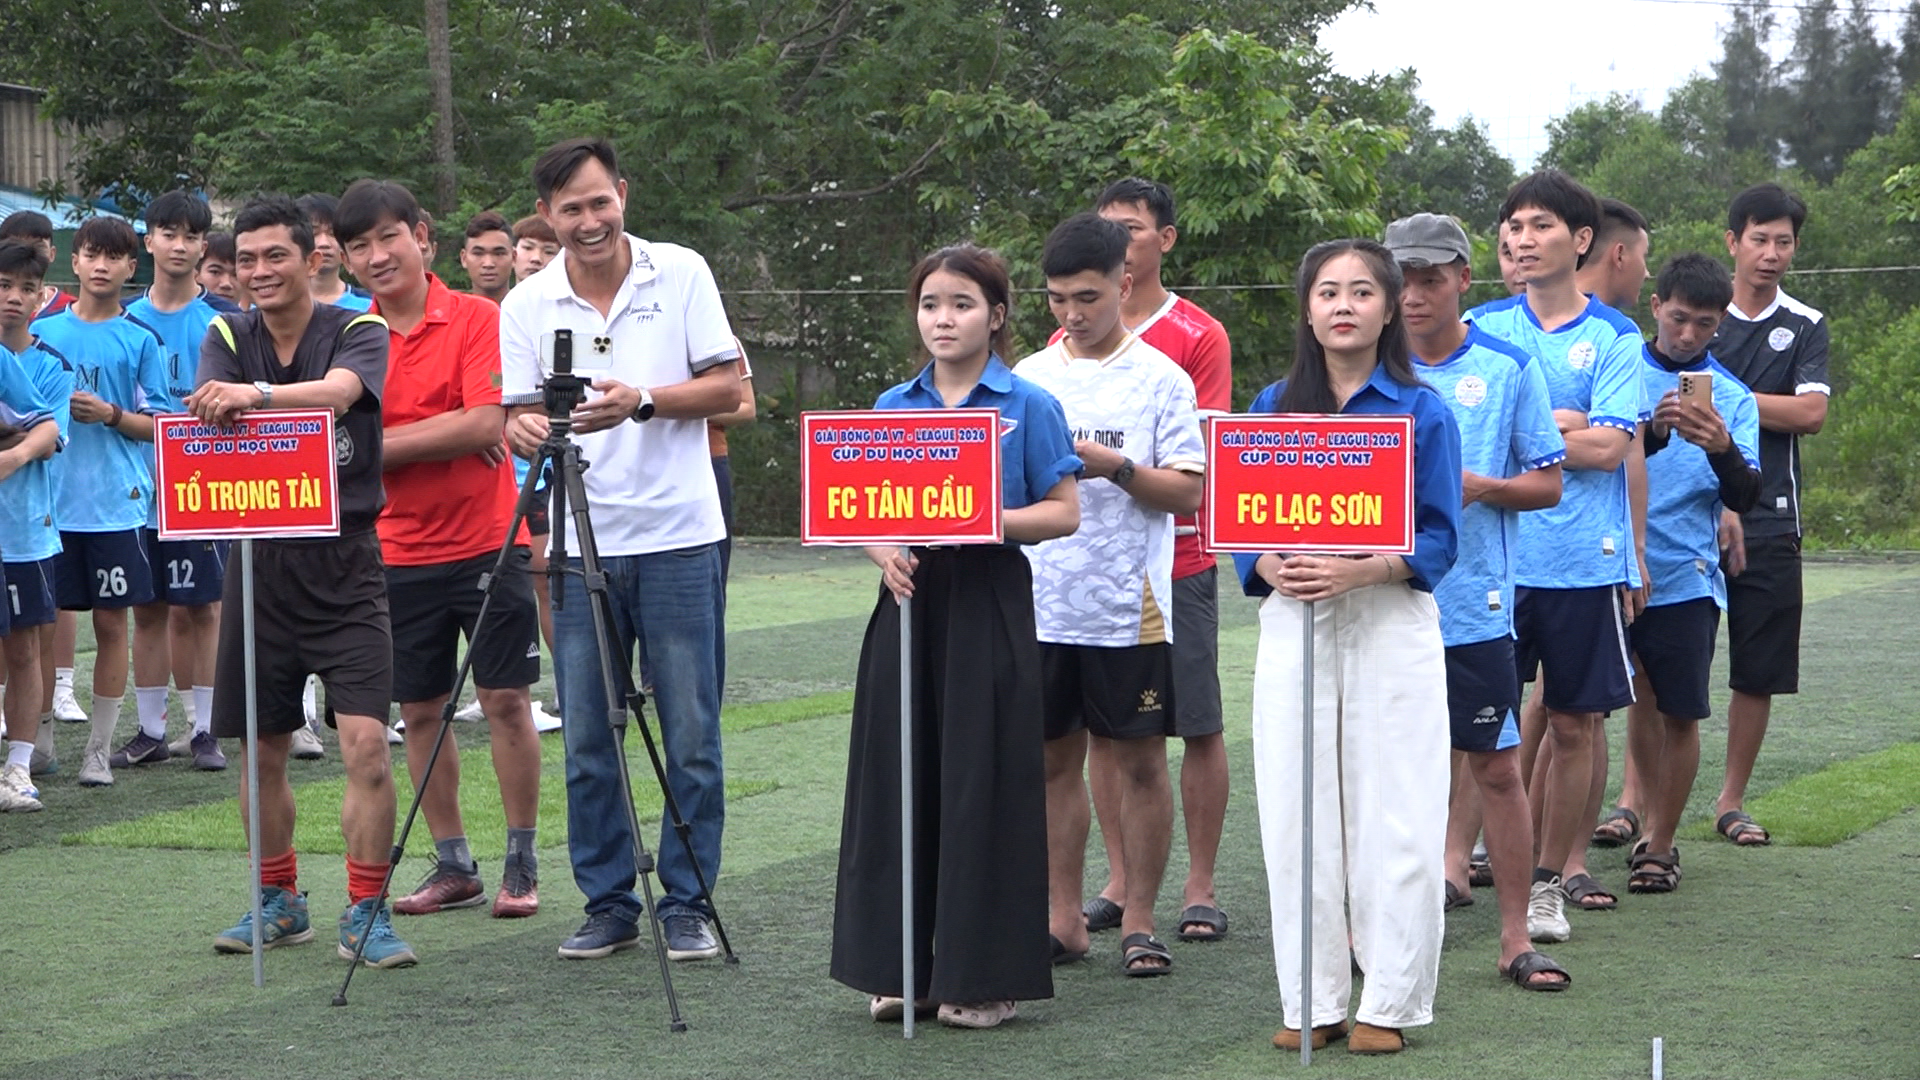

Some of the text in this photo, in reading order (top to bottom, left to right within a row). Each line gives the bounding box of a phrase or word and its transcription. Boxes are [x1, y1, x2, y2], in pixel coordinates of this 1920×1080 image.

[237, 423, 249, 435] VT
[258, 421, 294, 435] LEAGUE
[297, 420, 322, 433] 2026
[815, 427, 837, 444] GIẢI
[841, 427, 871, 443] BÓNG
[874, 427, 890, 443] ĐÁ
[892, 428, 904, 442] VT
[915, 428, 955, 442] LEAGUE
[958, 427, 986, 442] 2026
[214, 441, 233, 453] DU
[238, 440, 267, 455] HỌC
[270, 439, 298, 451] VNT
[1222, 429, 1246, 447] GIẢI
[1249, 429, 1281, 447] BÓNG
[1284, 429, 1300, 447] ĐÁ
[1303, 432, 1317, 447] VT
[1327, 432, 1368, 447] LEAGUE
[1371, 432, 1400, 447] 2026
[832, 445, 959, 463] CÚP DU HỌC VNT
[1240, 448, 1372, 468] CÚP DU HỌC VNT
[174, 470, 321, 517] TỔ TRỌNG TÀI
[827, 474, 973, 519] FC TÂN CẦU
[1237, 491, 1382, 531] FC LẠC SƠN
[97, 566, 128, 597] 26
[167, 559, 195, 588] 12
